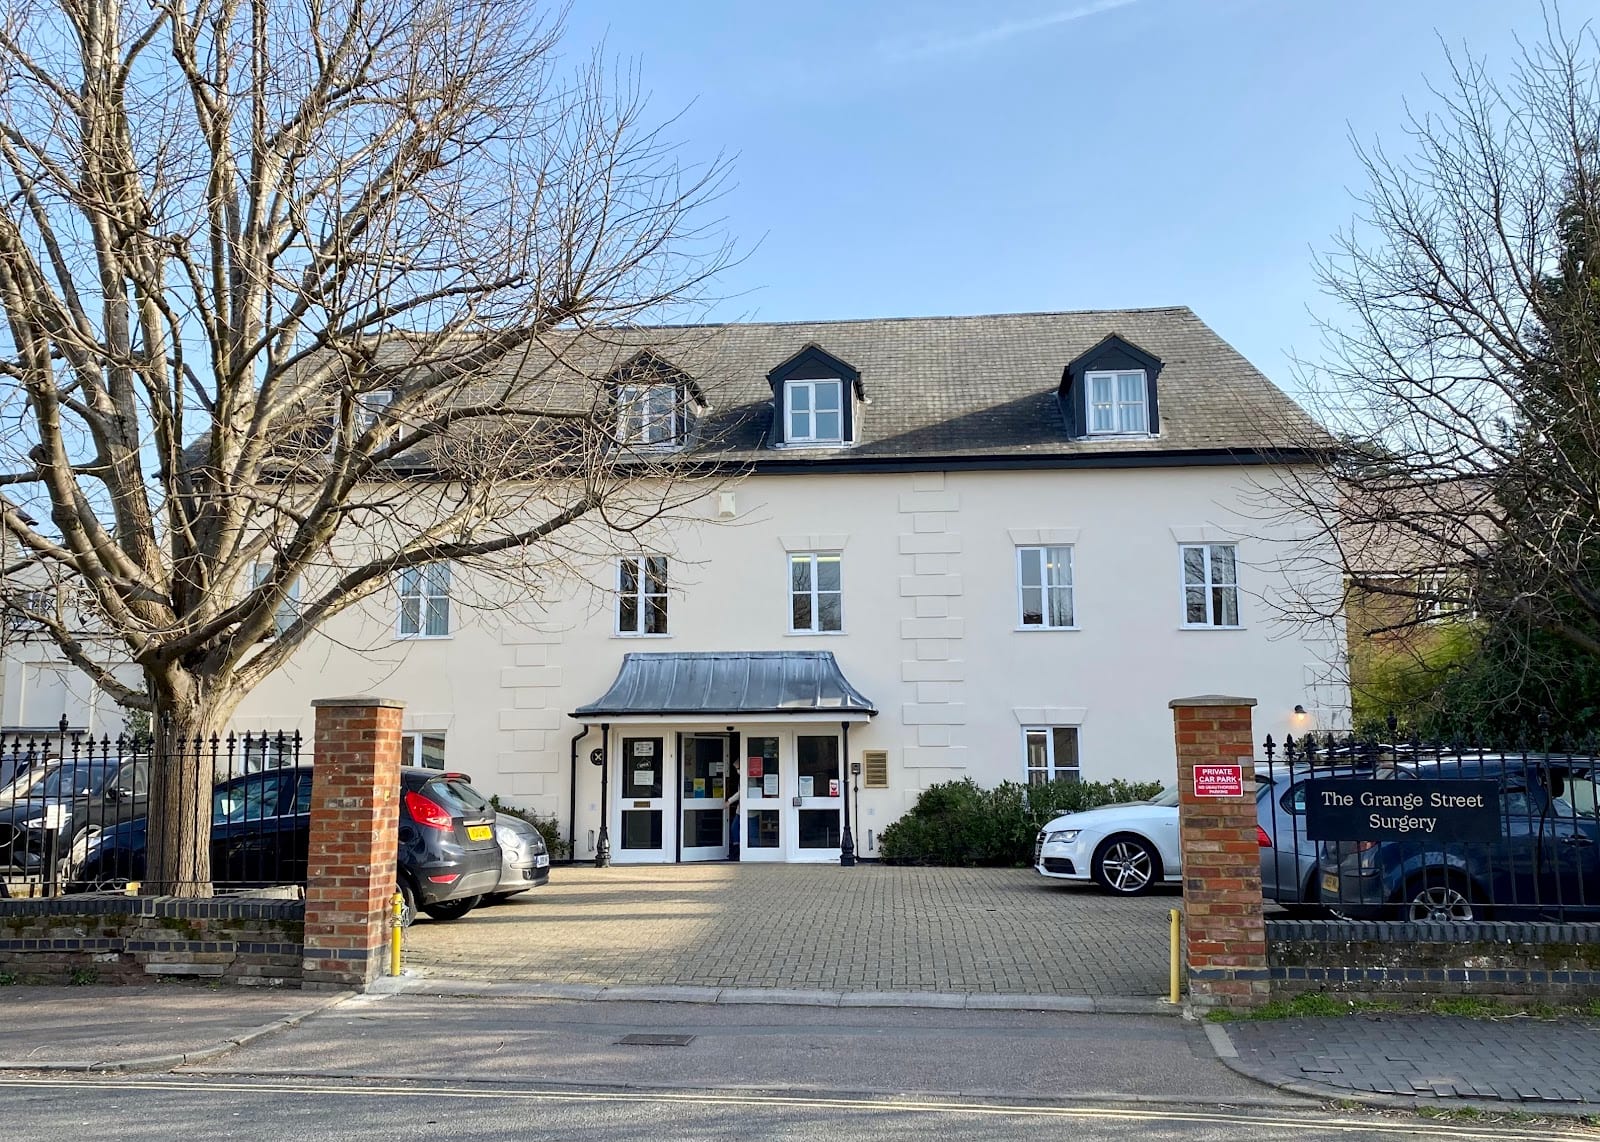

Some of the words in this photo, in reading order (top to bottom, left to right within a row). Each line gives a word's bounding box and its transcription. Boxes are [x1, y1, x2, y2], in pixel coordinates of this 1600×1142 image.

[1321, 791, 1353, 806] The
[1360, 791, 1423, 810] Grange
[1430, 792, 1483, 807] Street
[1369, 813, 1437, 833] Surgery
